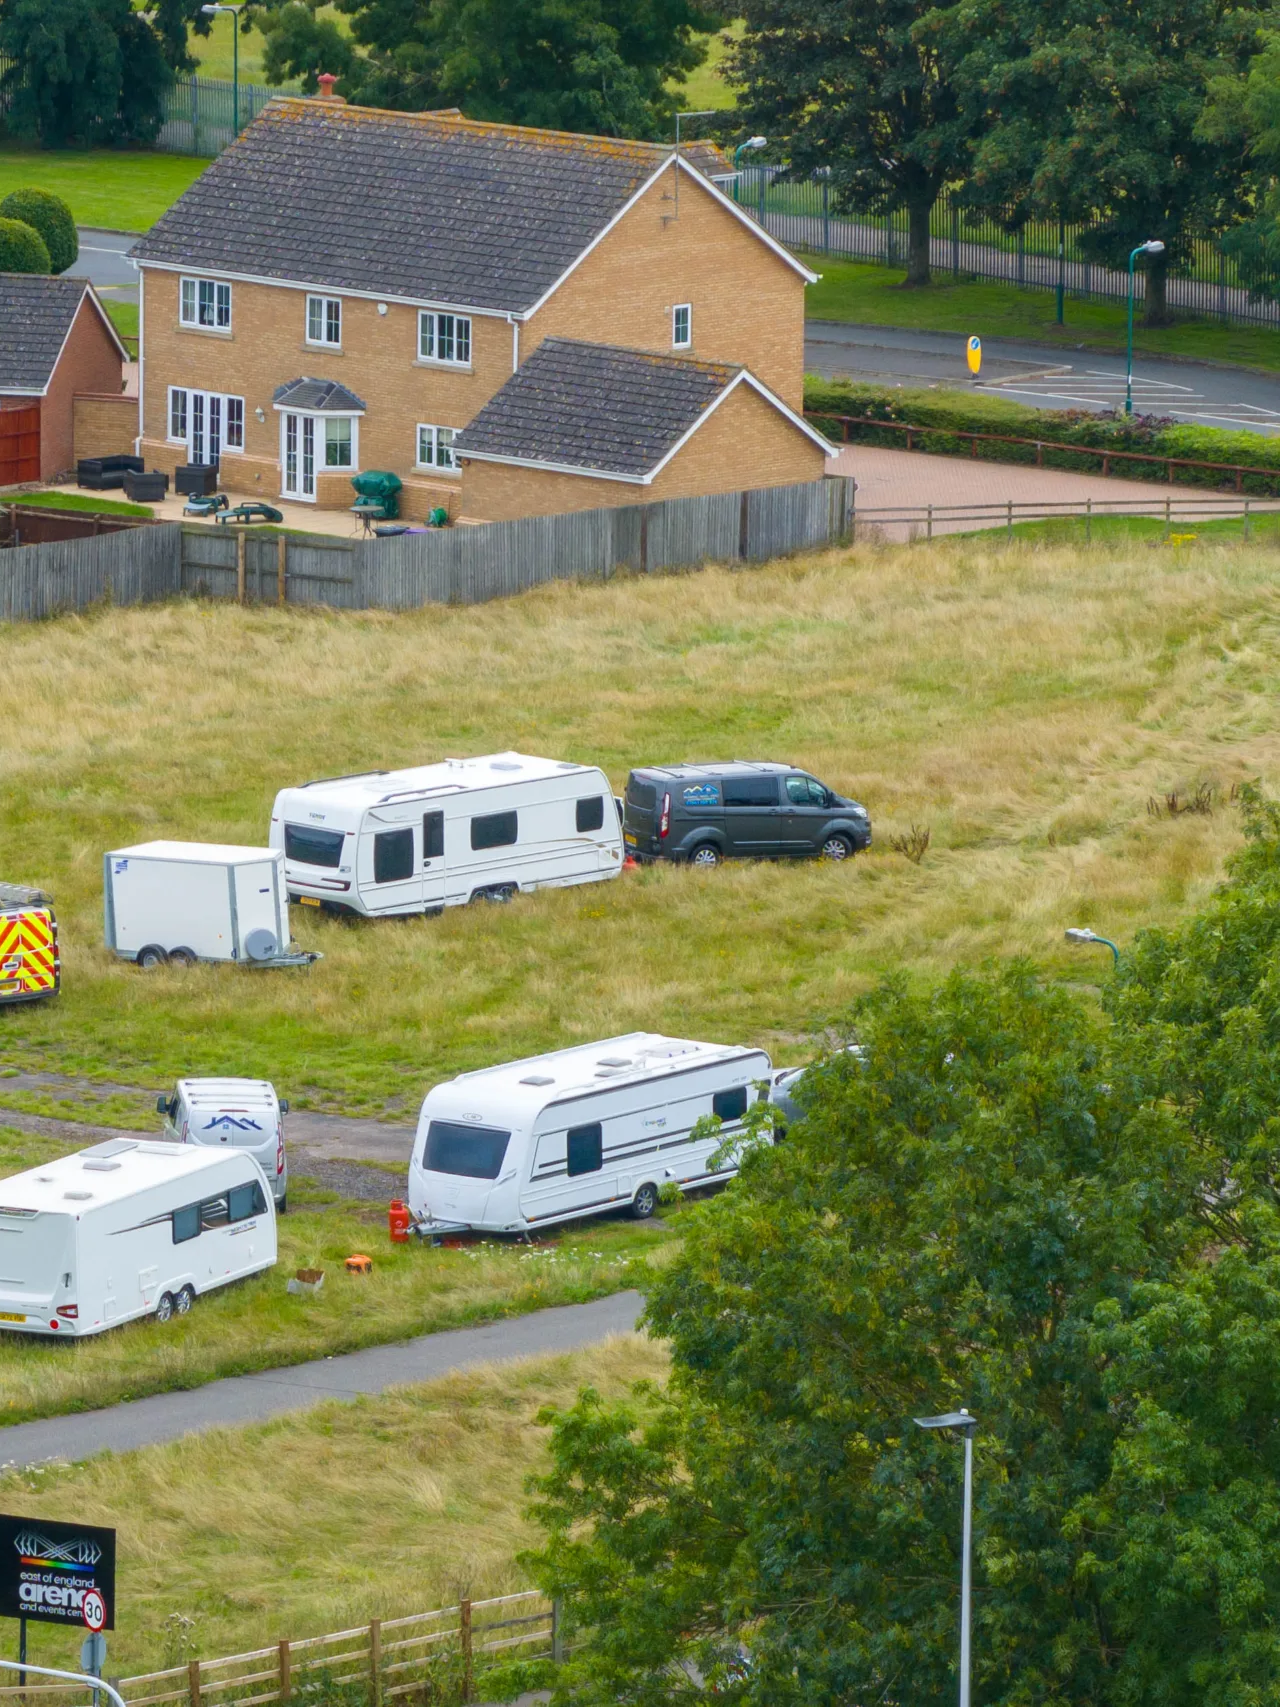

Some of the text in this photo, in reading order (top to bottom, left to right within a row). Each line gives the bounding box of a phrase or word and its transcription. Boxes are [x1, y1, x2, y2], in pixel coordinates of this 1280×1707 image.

[20, 1572, 95, 1588] east of england
[20, 1603, 37, 1611] and
[38, 1606, 66, 1616] events
[86, 1601, 103, 1622] 30
